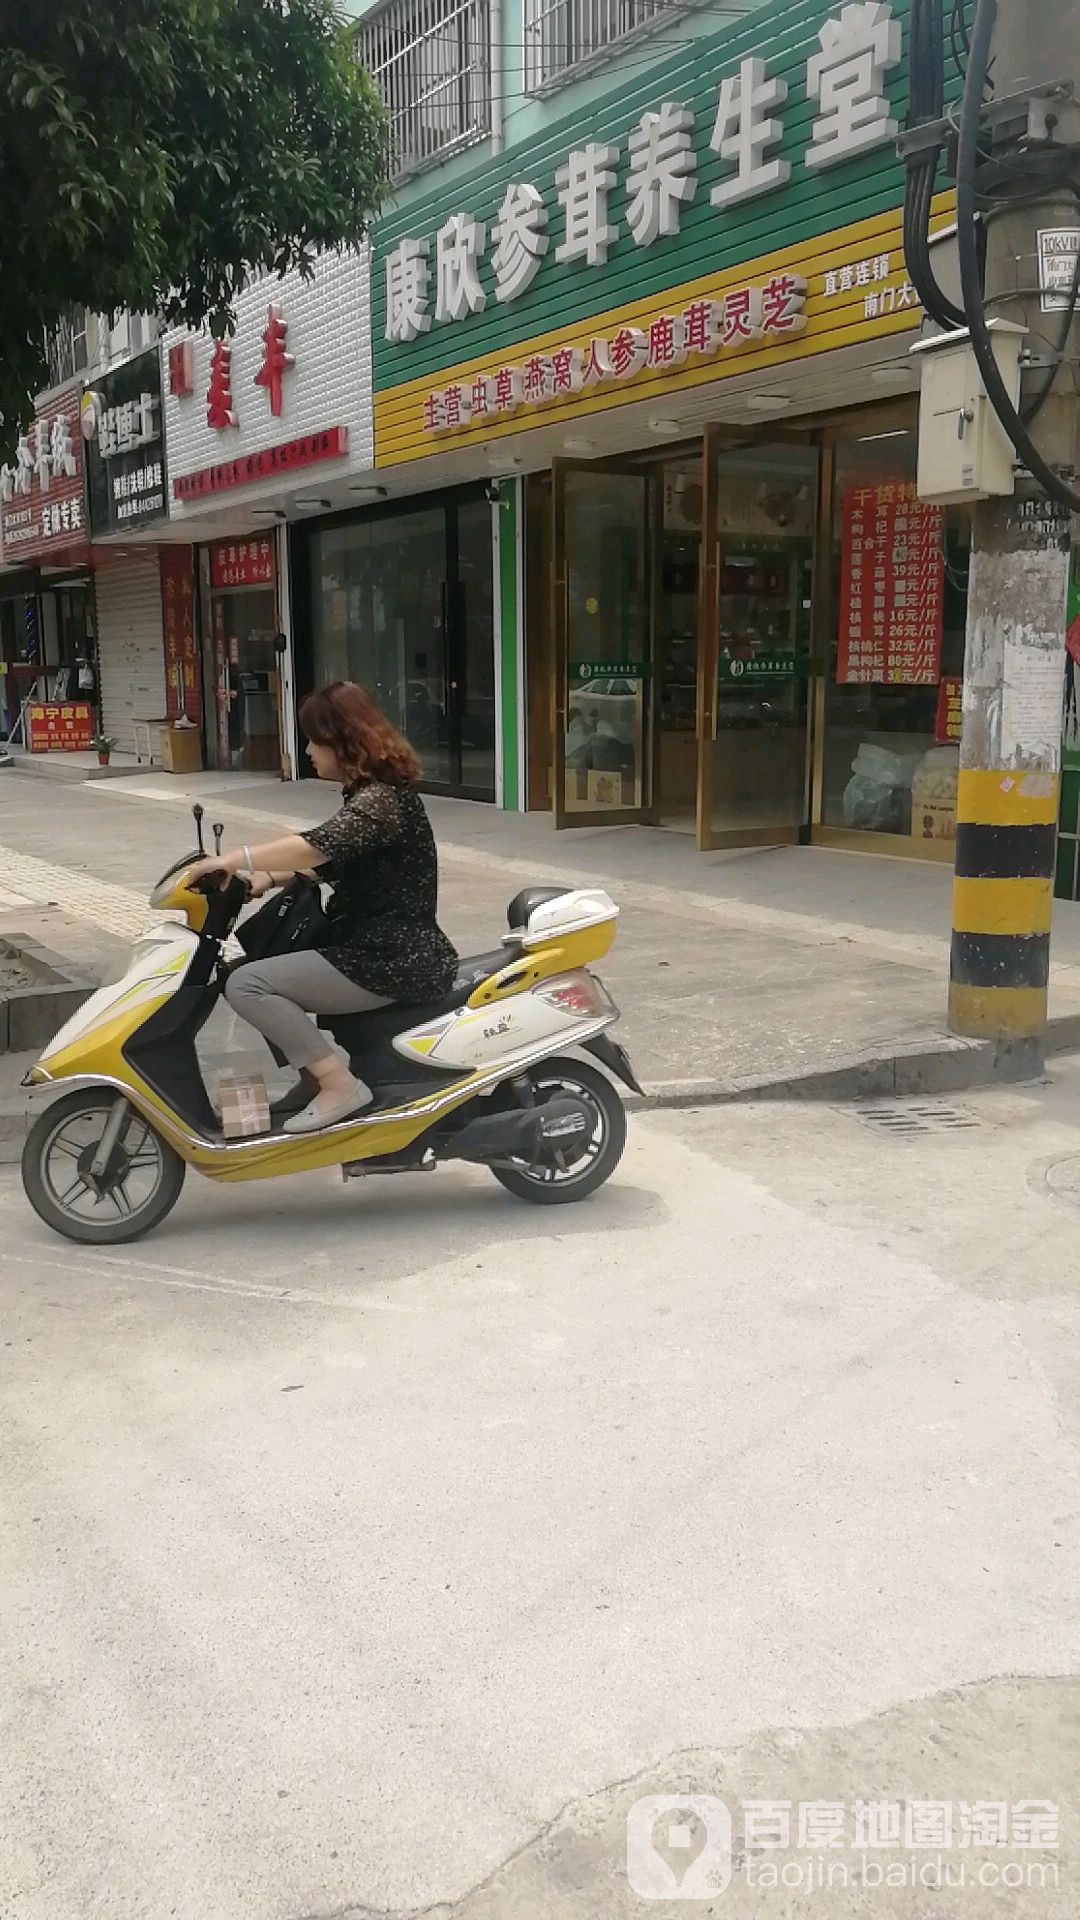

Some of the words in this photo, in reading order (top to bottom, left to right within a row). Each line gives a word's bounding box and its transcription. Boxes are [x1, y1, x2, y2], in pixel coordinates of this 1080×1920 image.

[384, 1, 900, 342] 康欣参茸养生堂
[824, 253, 890, 296] 直营连锁
[422, 274, 809, 433] 主营虫草燕窝人参鹿茸灵芝
[887, 667, 935, 684] 3元/斤
